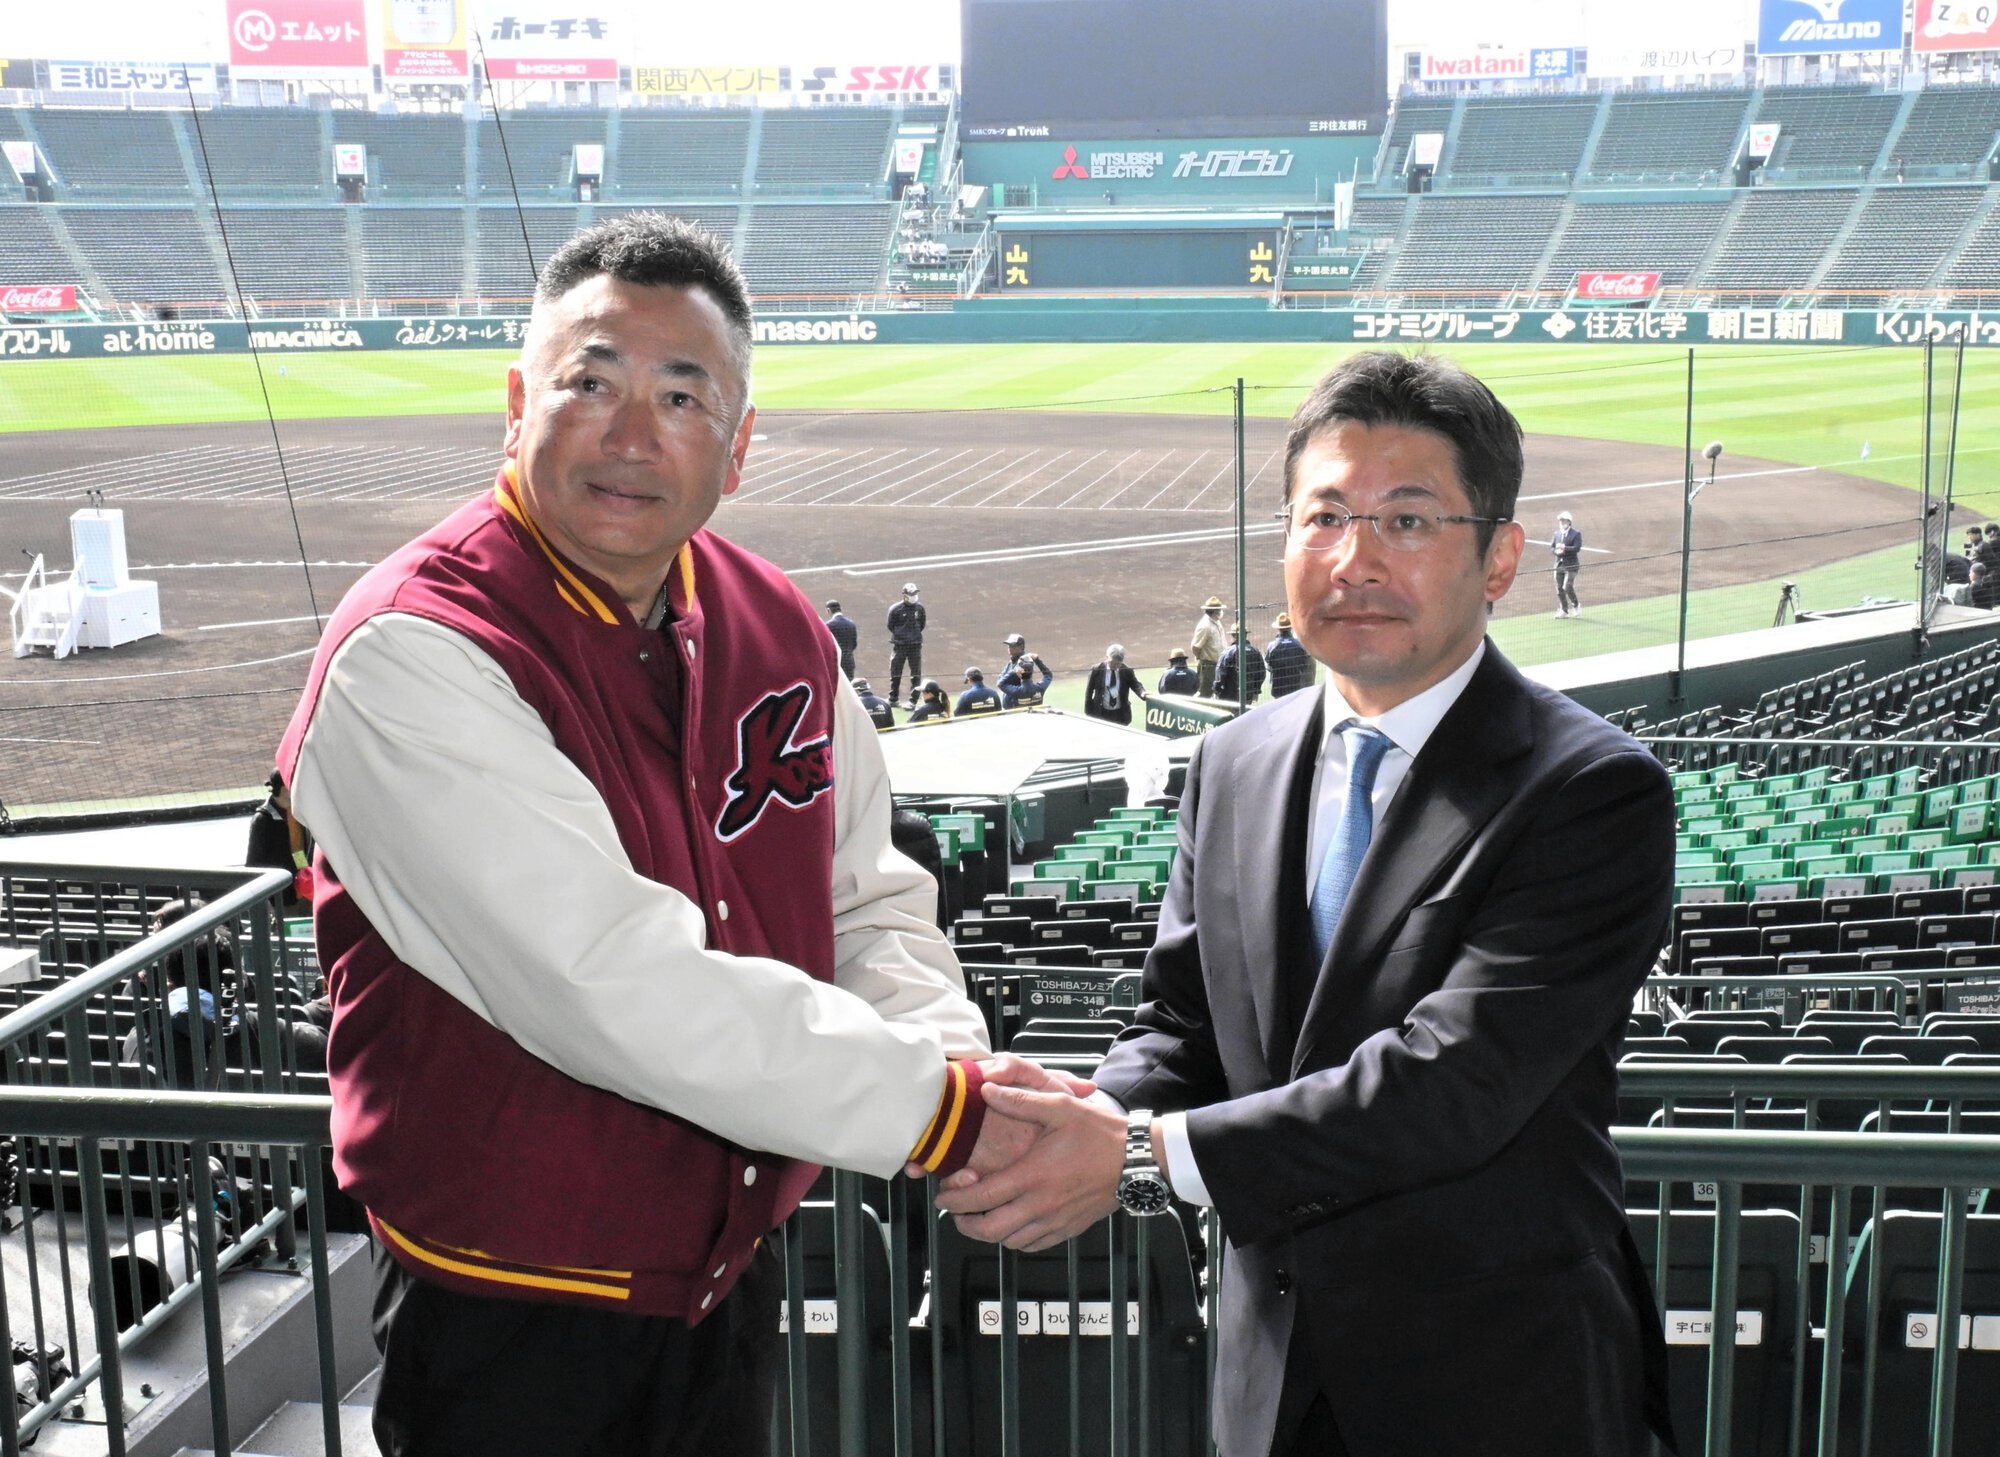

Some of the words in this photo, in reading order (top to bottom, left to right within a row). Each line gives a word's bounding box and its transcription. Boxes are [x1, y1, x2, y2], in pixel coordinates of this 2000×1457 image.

[281, 21, 360, 43] エムット
[491, 17, 608, 40] ホーチキ
[1427, 52, 1524, 76] Iwatani
[60, 67, 203, 89] 三和シャッター
[845, 65, 932, 91] SSK
[1017, 126, 1049, 136] Trunk
[1309, 120, 1367, 131] 三井住友銀行
[1091, 152, 1163, 166] MITSUBISHI
[1091, 165, 1154, 179] ELECTRIC
[1006, 244, 1028, 284] 山九
[1250, 242, 1272, 282] 山九
[752, 314, 877, 341] nasonic
[1353, 312, 1521, 338] コナミグループ
[1582, 311, 1687, 338] 住友化学
[1708, 311, 1843, 339] 朝日新聞
[1876, 311, 2000, 344] Kubota
[135, 325, 215, 352] home
[1147, 708, 1176, 729] au
[1698, 1183, 1713, 1196] 36
